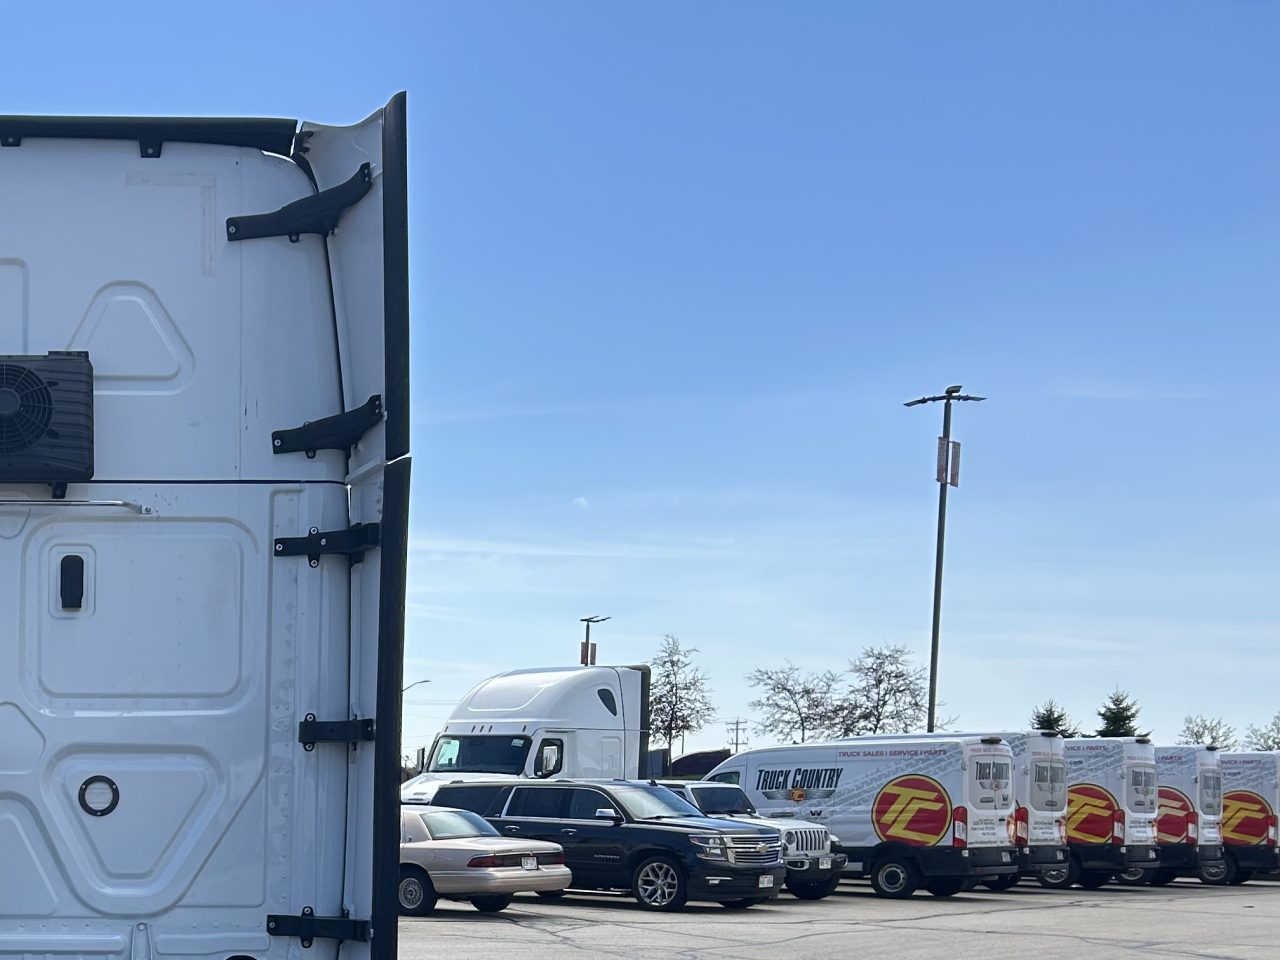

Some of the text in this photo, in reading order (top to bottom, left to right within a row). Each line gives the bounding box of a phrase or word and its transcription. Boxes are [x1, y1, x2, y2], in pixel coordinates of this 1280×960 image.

[755, 767, 844, 790] TRUCK COUNTRY
[880, 784, 945, 845] TC
